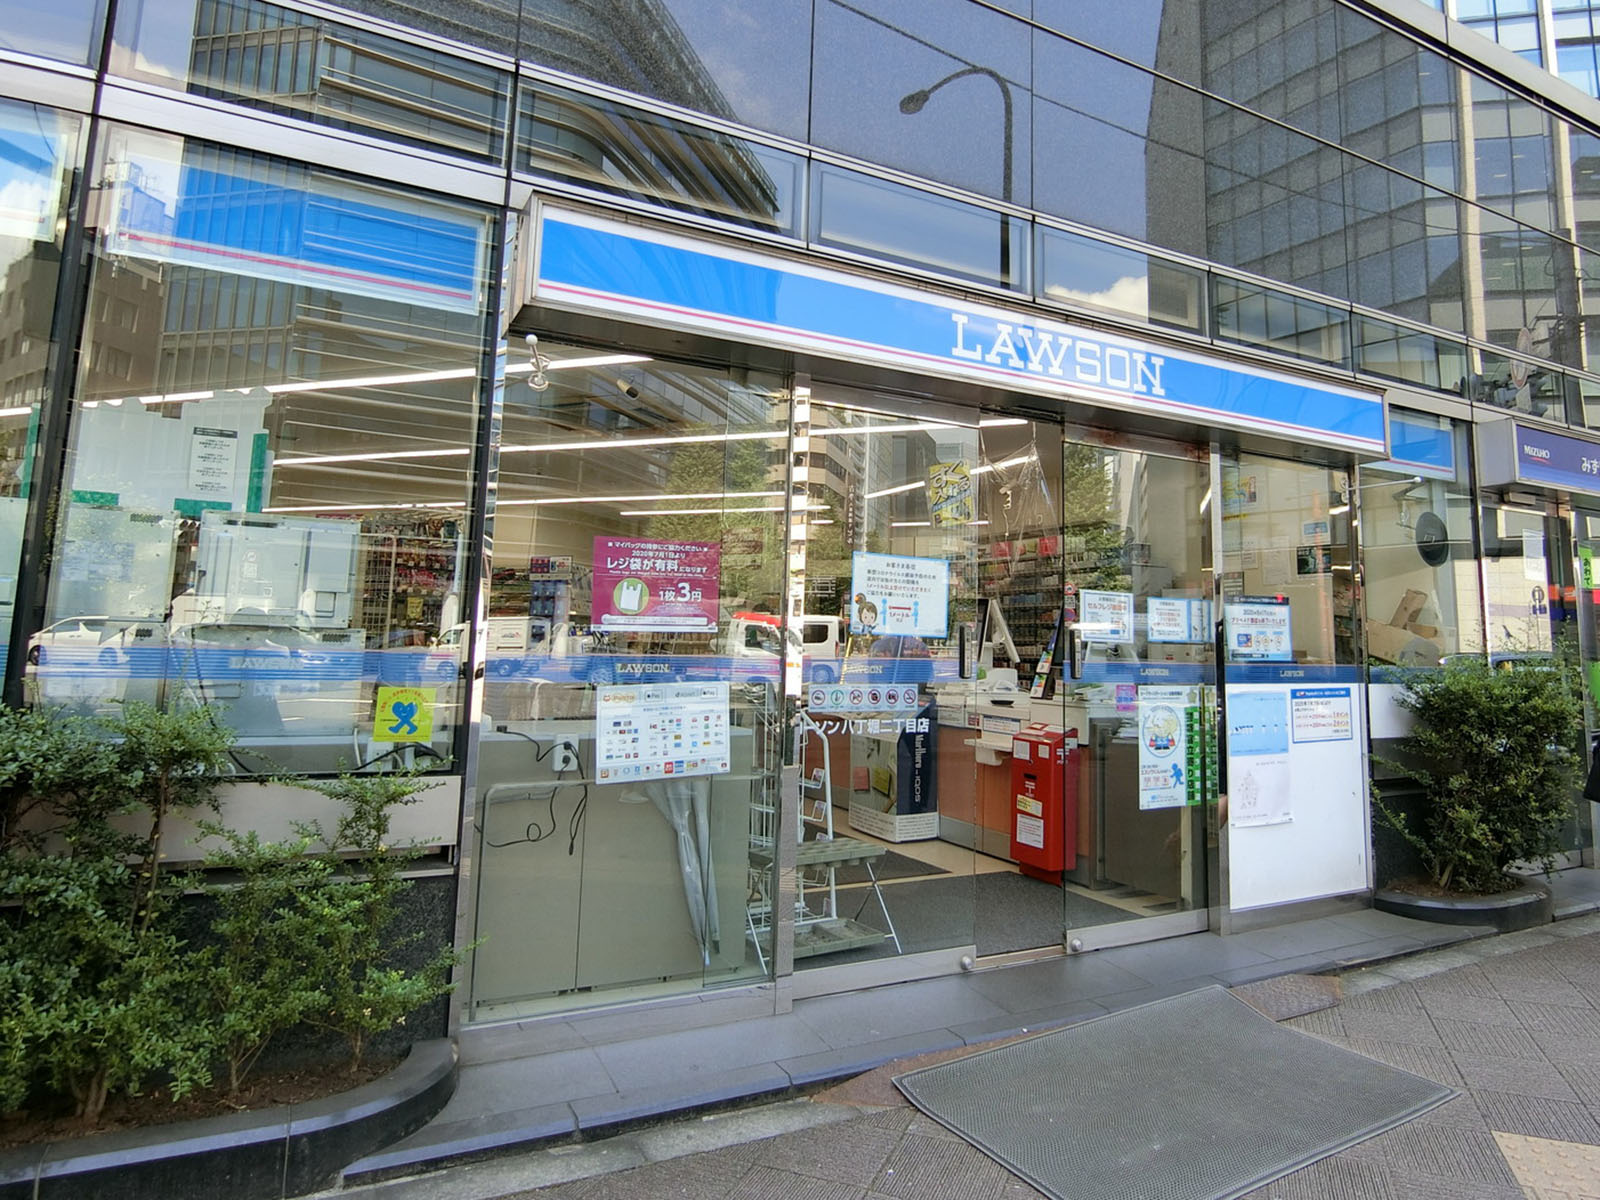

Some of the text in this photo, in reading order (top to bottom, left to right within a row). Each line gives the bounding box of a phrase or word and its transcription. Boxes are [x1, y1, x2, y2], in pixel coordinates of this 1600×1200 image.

[951, 313, 1165, 396] LAWSON
[1523, 444, 1550, 459] MIZUHO
[607, 557, 708, 573] レジ袋が有料になります
[658, 582, 702, 602] 1枚3円
[616, 663, 670, 673] LAWSON
[799, 718, 930, 735] ーソン八丁堀二丁目店
[914, 734, 927, 769] Marlboro
